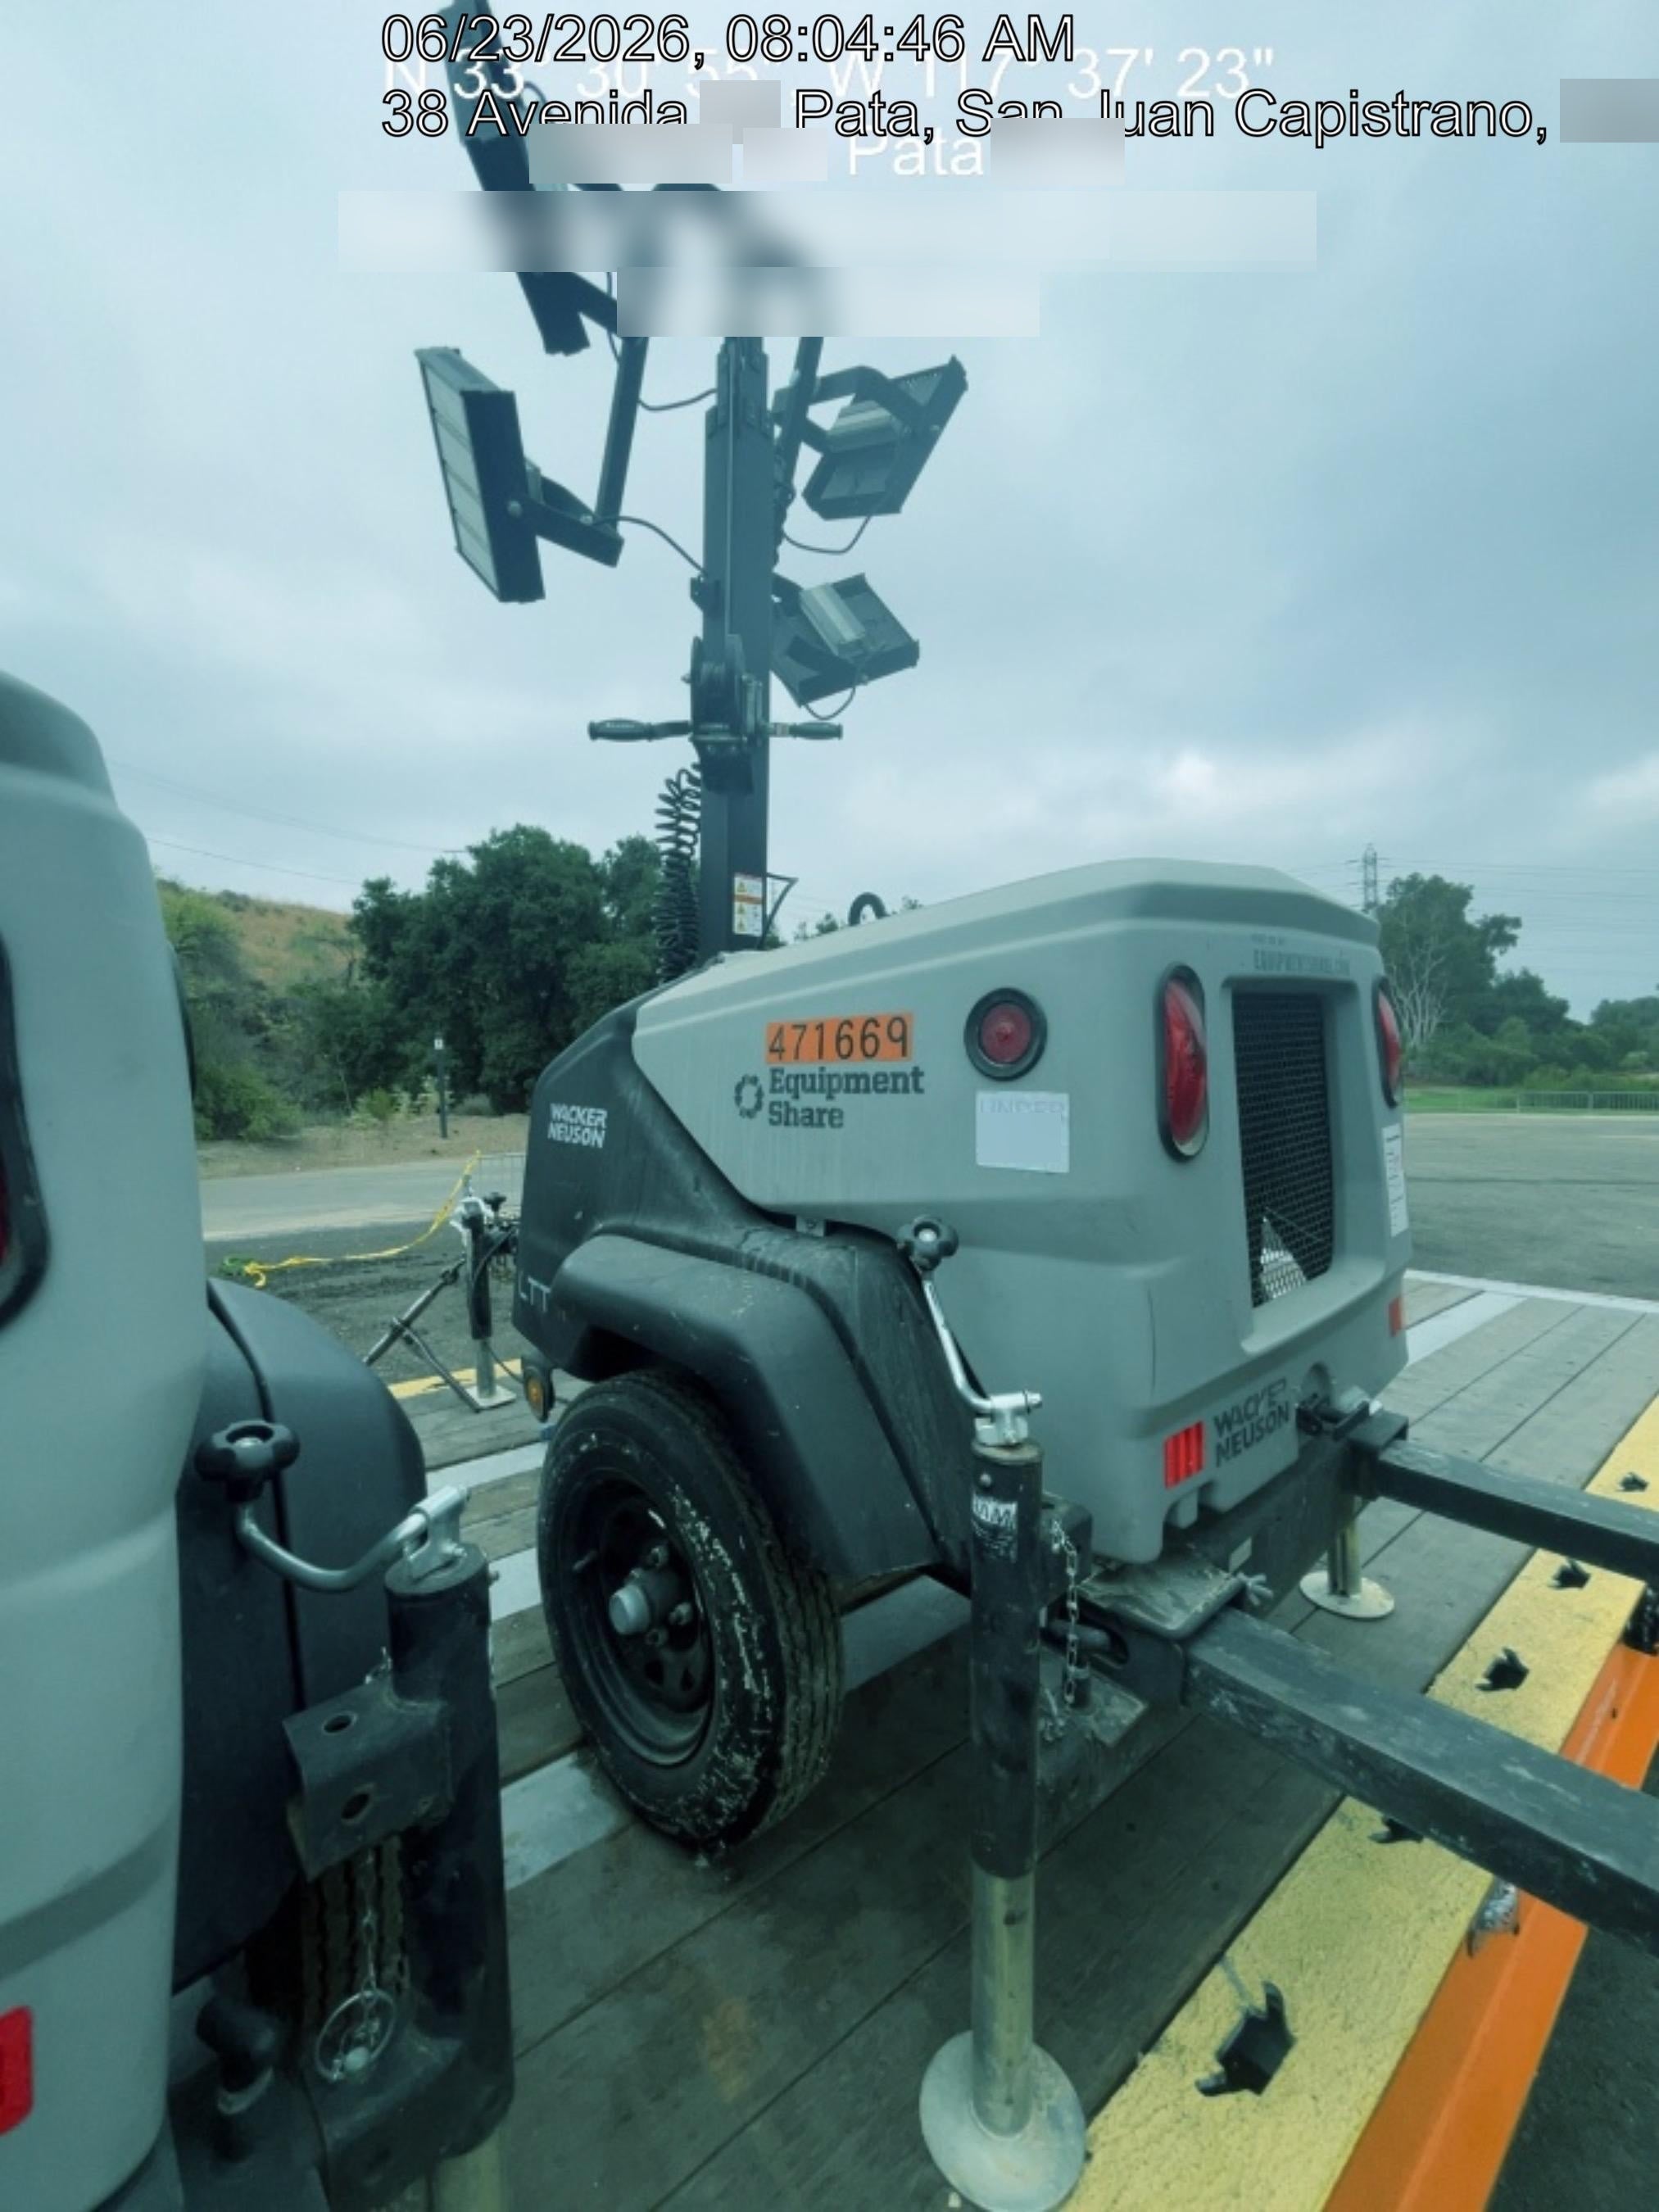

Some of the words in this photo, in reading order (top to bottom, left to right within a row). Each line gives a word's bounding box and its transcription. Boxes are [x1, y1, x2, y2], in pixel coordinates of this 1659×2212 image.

[768, 1017, 908, 1060] 471669
[768, 1066, 925, 1100] Equipment
[550, 1104, 608, 1129] WACKER
[768, 1100, 845, 1129] Share
[547, 1122, 606, 1148] NEUSON
[1217, 1401, 1290, 1467] NEUSON
